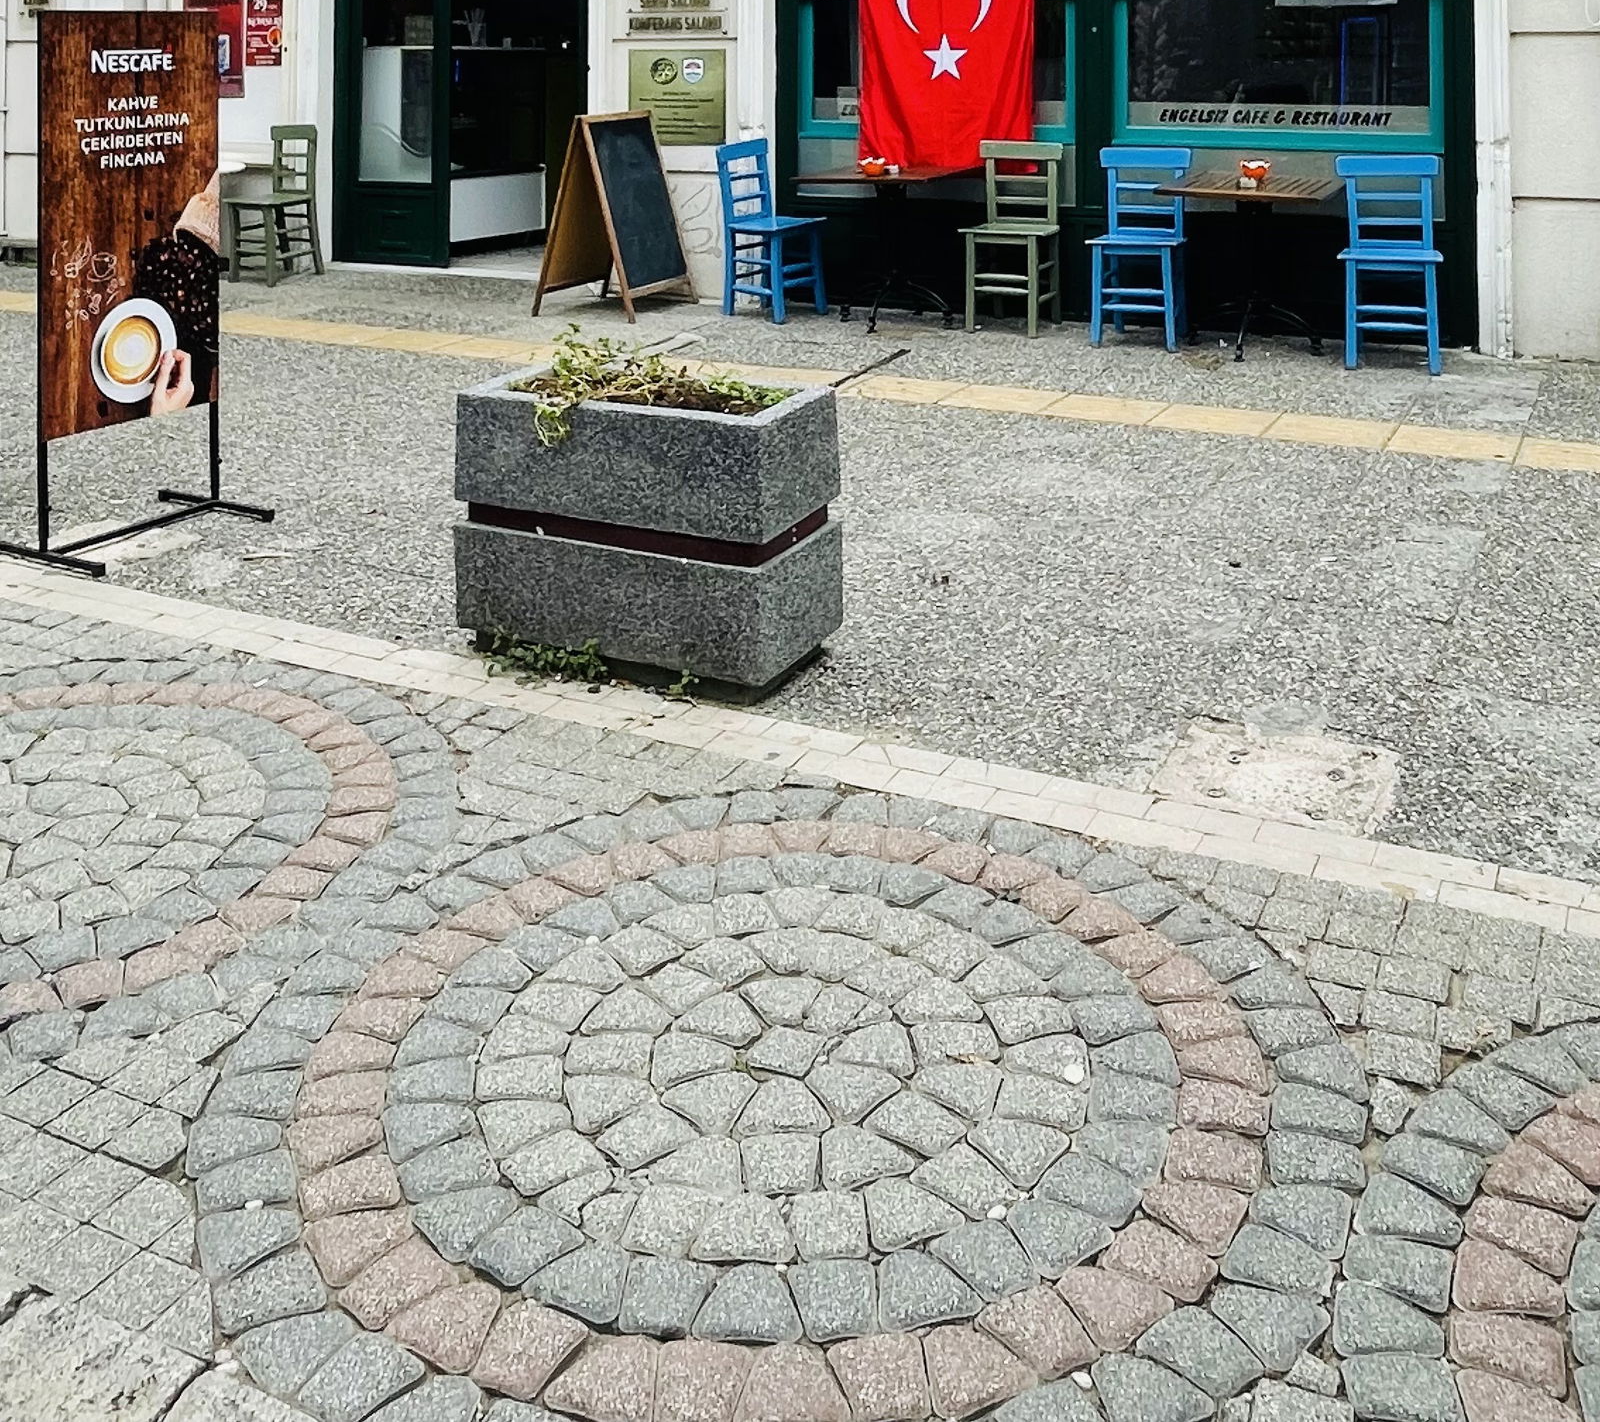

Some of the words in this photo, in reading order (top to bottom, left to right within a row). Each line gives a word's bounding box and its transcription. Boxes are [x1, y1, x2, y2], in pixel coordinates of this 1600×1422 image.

[107, 95, 159, 112] KAHVE
[74, 112, 190, 133] TUTKUNLARINA
[1232, 109, 1270, 125] CAFE
[1290, 110, 1393, 127] RESTAURANT
[81, 131, 184, 155] ÇEKİRDEKTEN
[100, 151, 166, 170] FİNCANA
